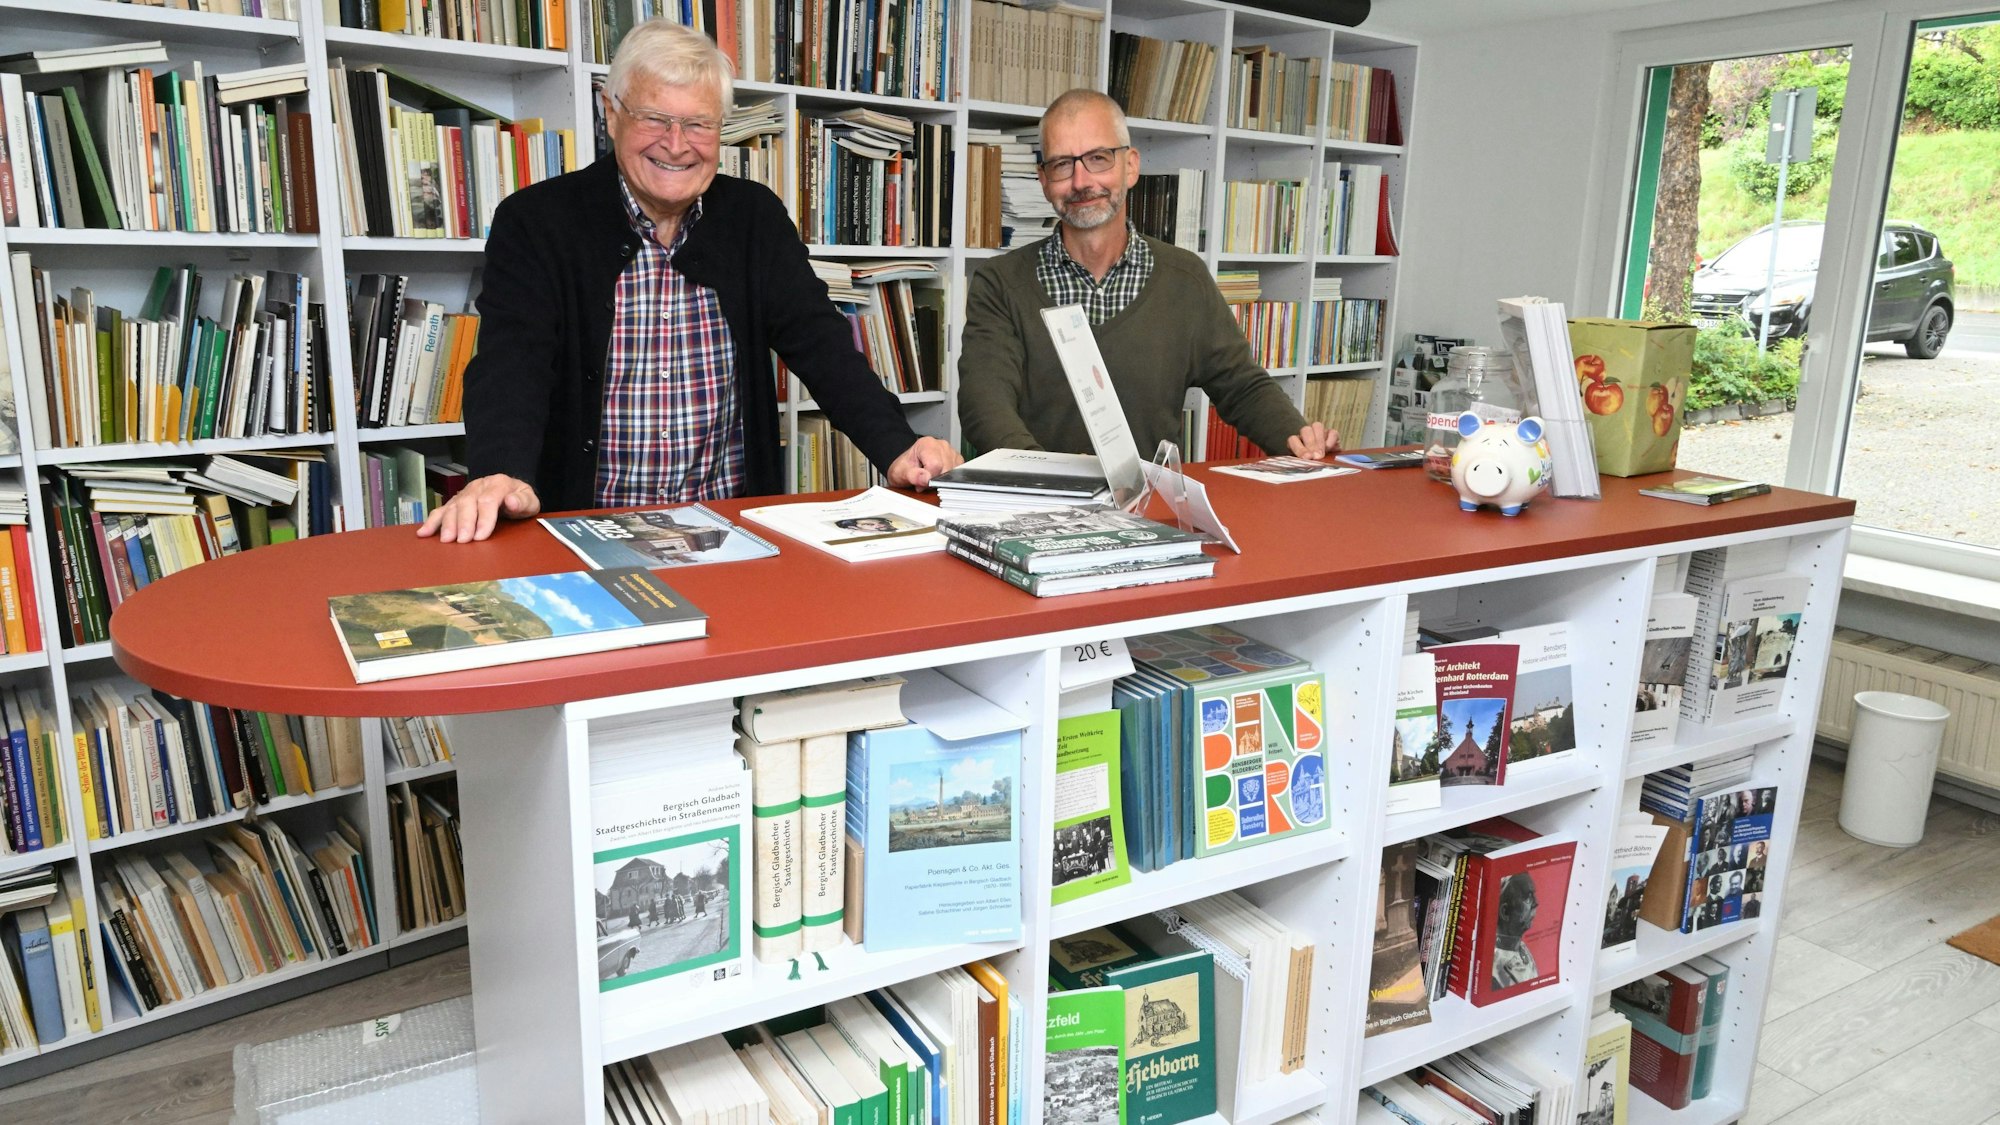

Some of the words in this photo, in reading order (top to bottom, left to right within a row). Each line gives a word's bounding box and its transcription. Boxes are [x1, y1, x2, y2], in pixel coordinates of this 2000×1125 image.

[424, 314, 439, 352] Refrath
[585, 519, 634, 539] 2023
[1074, 642, 1096, 662] 20
[1100, 640, 1113, 658] €
[1543, 642, 1567, 653] Bensberg
[1434, 664, 1446, 673] Der
[1446, 661, 1481, 672] Architekt
[1466, 672, 1509, 681] Rotterdam
[1062, 734, 1078, 742] Ersten
[1079, 729, 1104, 738] Weltkrieg
[2, 746, 10, 761] Land
[147, 746, 159, 781] Wuppertal
[1231, 757, 1263, 769] BENSBERGER
[6, 761, 16, 790] Bergischen
[1231, 764, 1263, 775] BILDERBUCH
[80, 772, 91, 794] Schule
[663, 799, 699, 812] Bergisch
[702, 791, 741, 804] Gladbach
[26, 810, 34, 825] JAHRE
[595, 817, 667, 836] Stadtgeschichte
[679, 802, 741, 820] Straßennamen
[772, 822, 780, 871] Gladbacher
[829, 809, 839, 876] Stadtgeschichte
[783, 819, 793, 887] Stadtgeschichte
[818, 861, 828, 897] Bergisch
[927, 866, 961, 876] Poensgen
[968, 864, 979, 872] Co.
[1456, 878, 1464, 901] Bergisch
[1460, 855, 1468, 879] Gladbach
[773, 874, 783, 908] Bergisch
[1379, 1015, 1403, 1026] Bergisch
[1402, 1008, 1428, 1020] Gladbach
[1126, 1053, 1200, 1095] Hebborn
[1154, 1079, 1173, 1088] BEITRAG
[1145, 1092, 1168, 1102] BERGISCH
[1168, 1085, 1194, 1096] GLADBACHS
[1155, 1078, 1198, 1095] HEIMATGESCHICHTE
